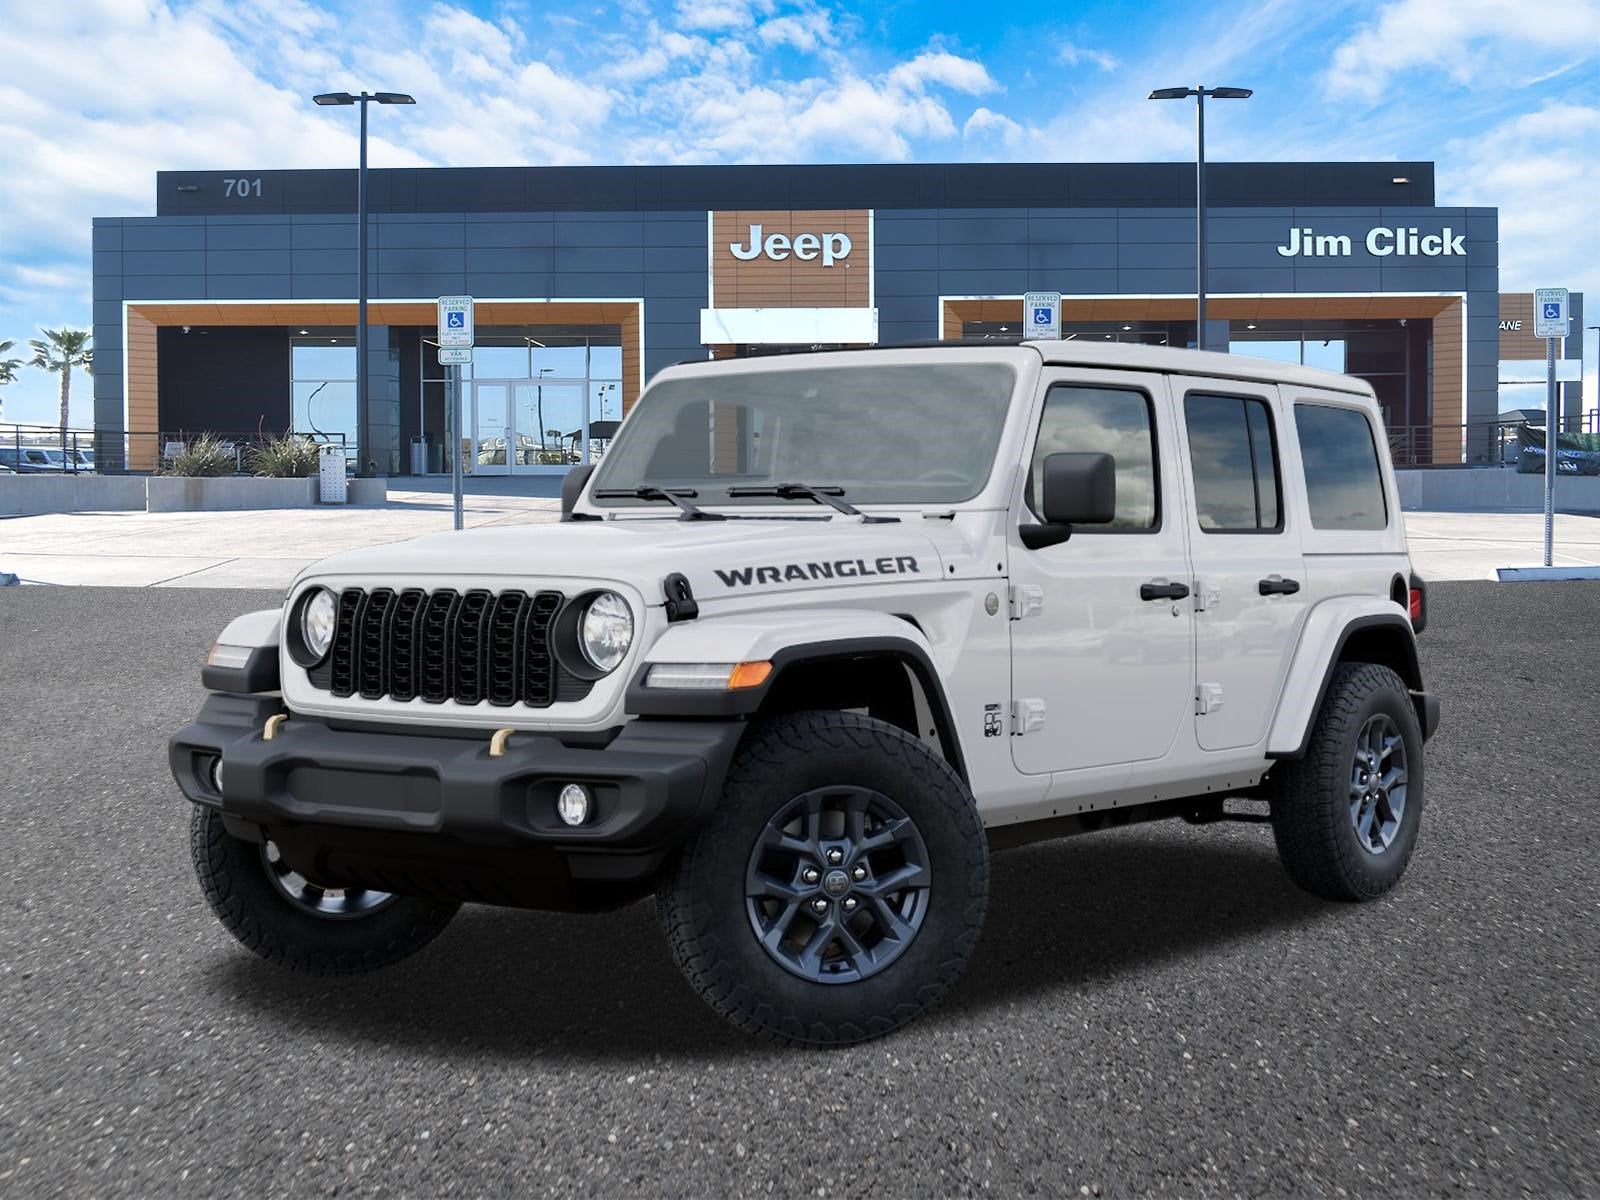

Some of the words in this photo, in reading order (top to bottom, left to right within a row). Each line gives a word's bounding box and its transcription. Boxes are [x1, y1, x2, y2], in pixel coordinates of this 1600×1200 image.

[223, 178, 262, 198] 701
[729, 223, 853, 267] Jeep
[1276, 227, 1352, 257] Jim
[1365, 226, 1467, 257] Click
[713, 555, 921, 588] WRANGLER
